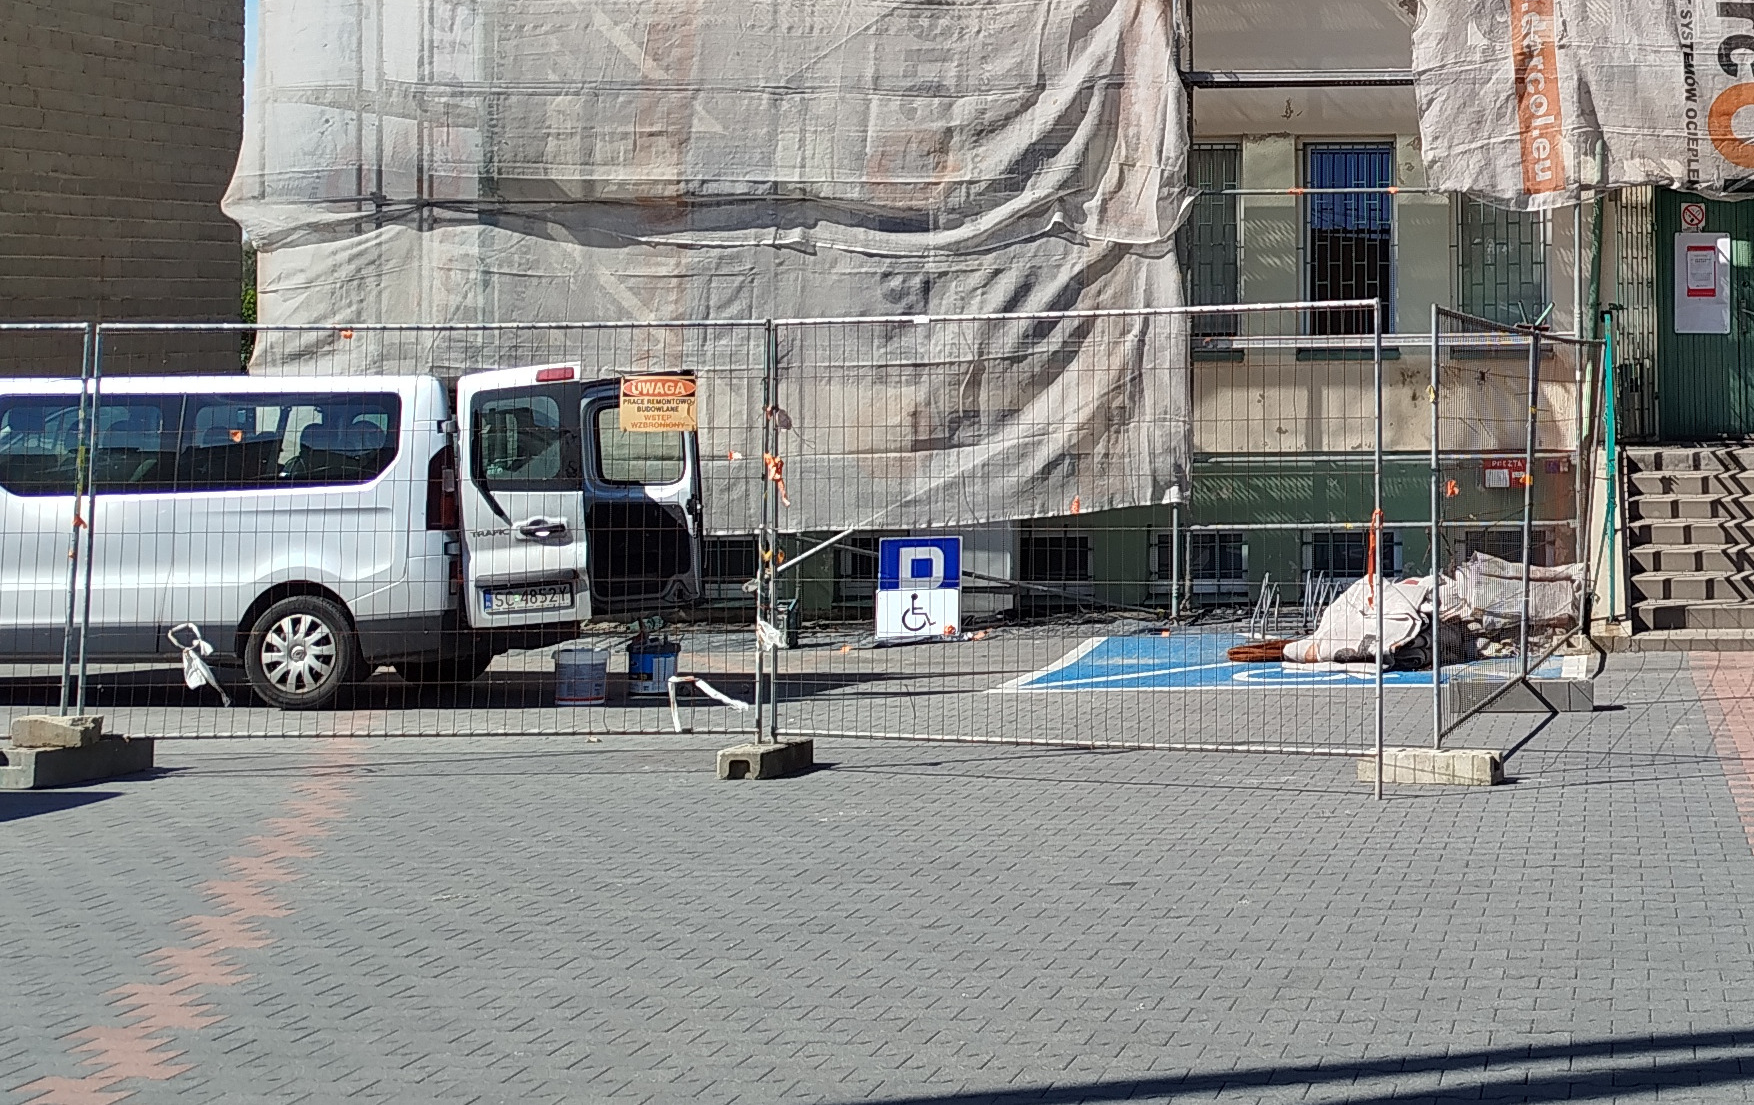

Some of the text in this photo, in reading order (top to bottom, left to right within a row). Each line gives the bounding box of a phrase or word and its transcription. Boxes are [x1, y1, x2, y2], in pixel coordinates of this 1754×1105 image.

[1678, 9, 1698, 103] SYSTEMÓW
[632, 382, 685, 394] UWAGA
[470, 528, 511, 538] TRAFIC
[900, 546, 945, 590] P
[494, 592, 515, 608] SC
[520, 585, 567, 607] 4852Y
